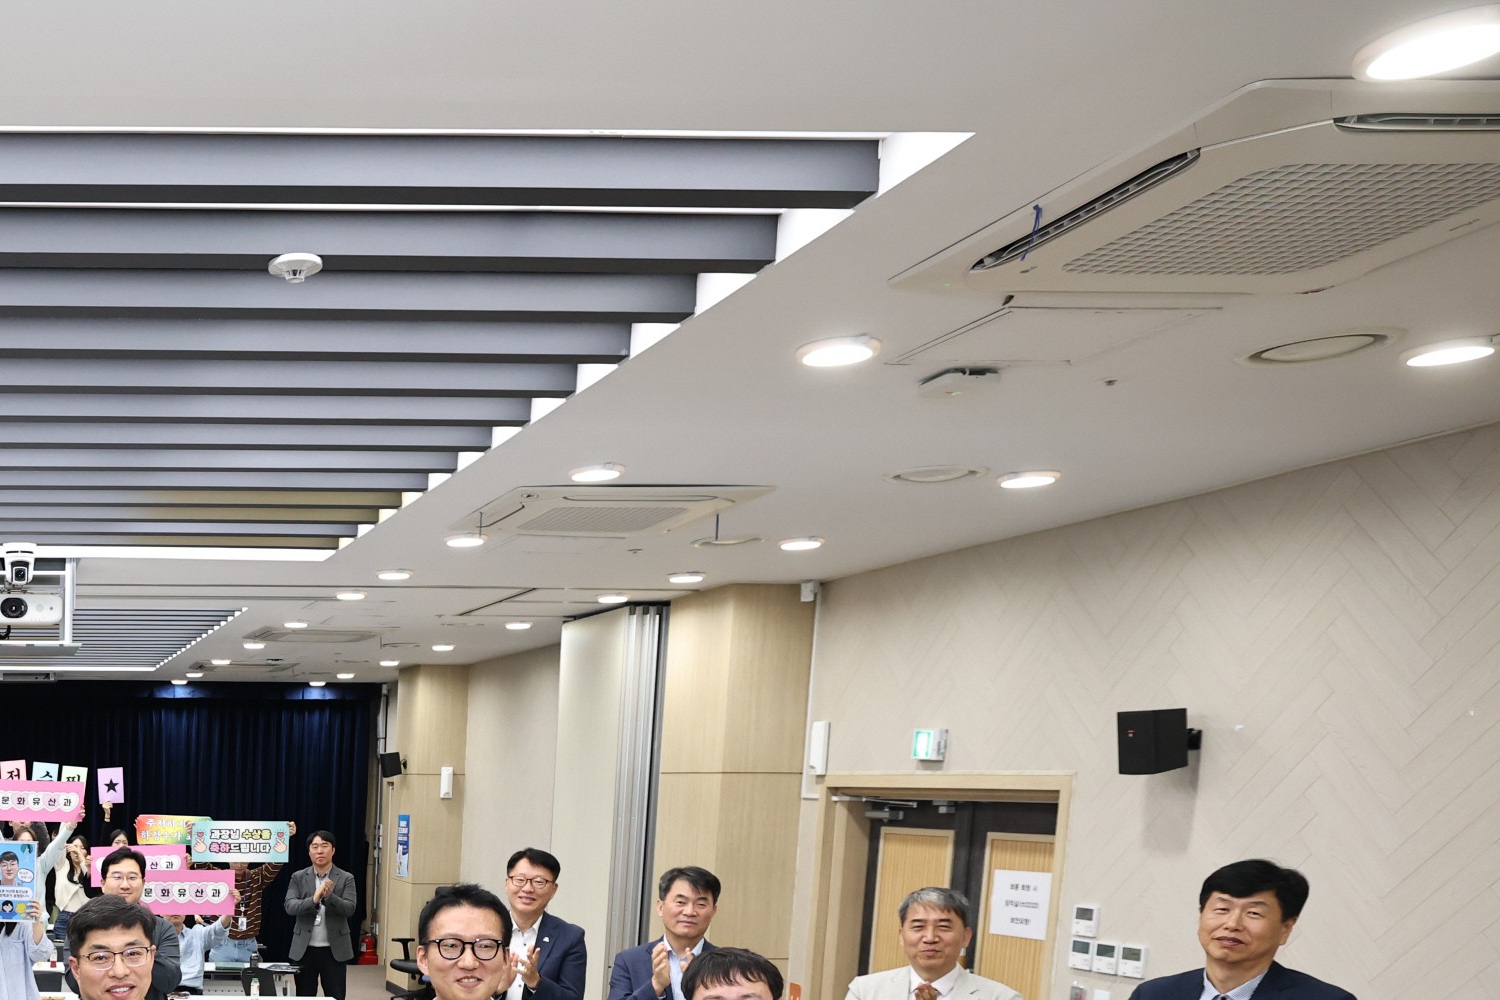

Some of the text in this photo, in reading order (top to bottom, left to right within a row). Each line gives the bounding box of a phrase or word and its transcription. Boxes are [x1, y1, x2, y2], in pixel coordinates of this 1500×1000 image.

[1, 796, 71, 807] 문화유산과
[209, 829, 271, 840] 과장님 수상을
[209, 842, 271, 853] 축하드립니다
[144, 888, 221, 898] 문화유산과
